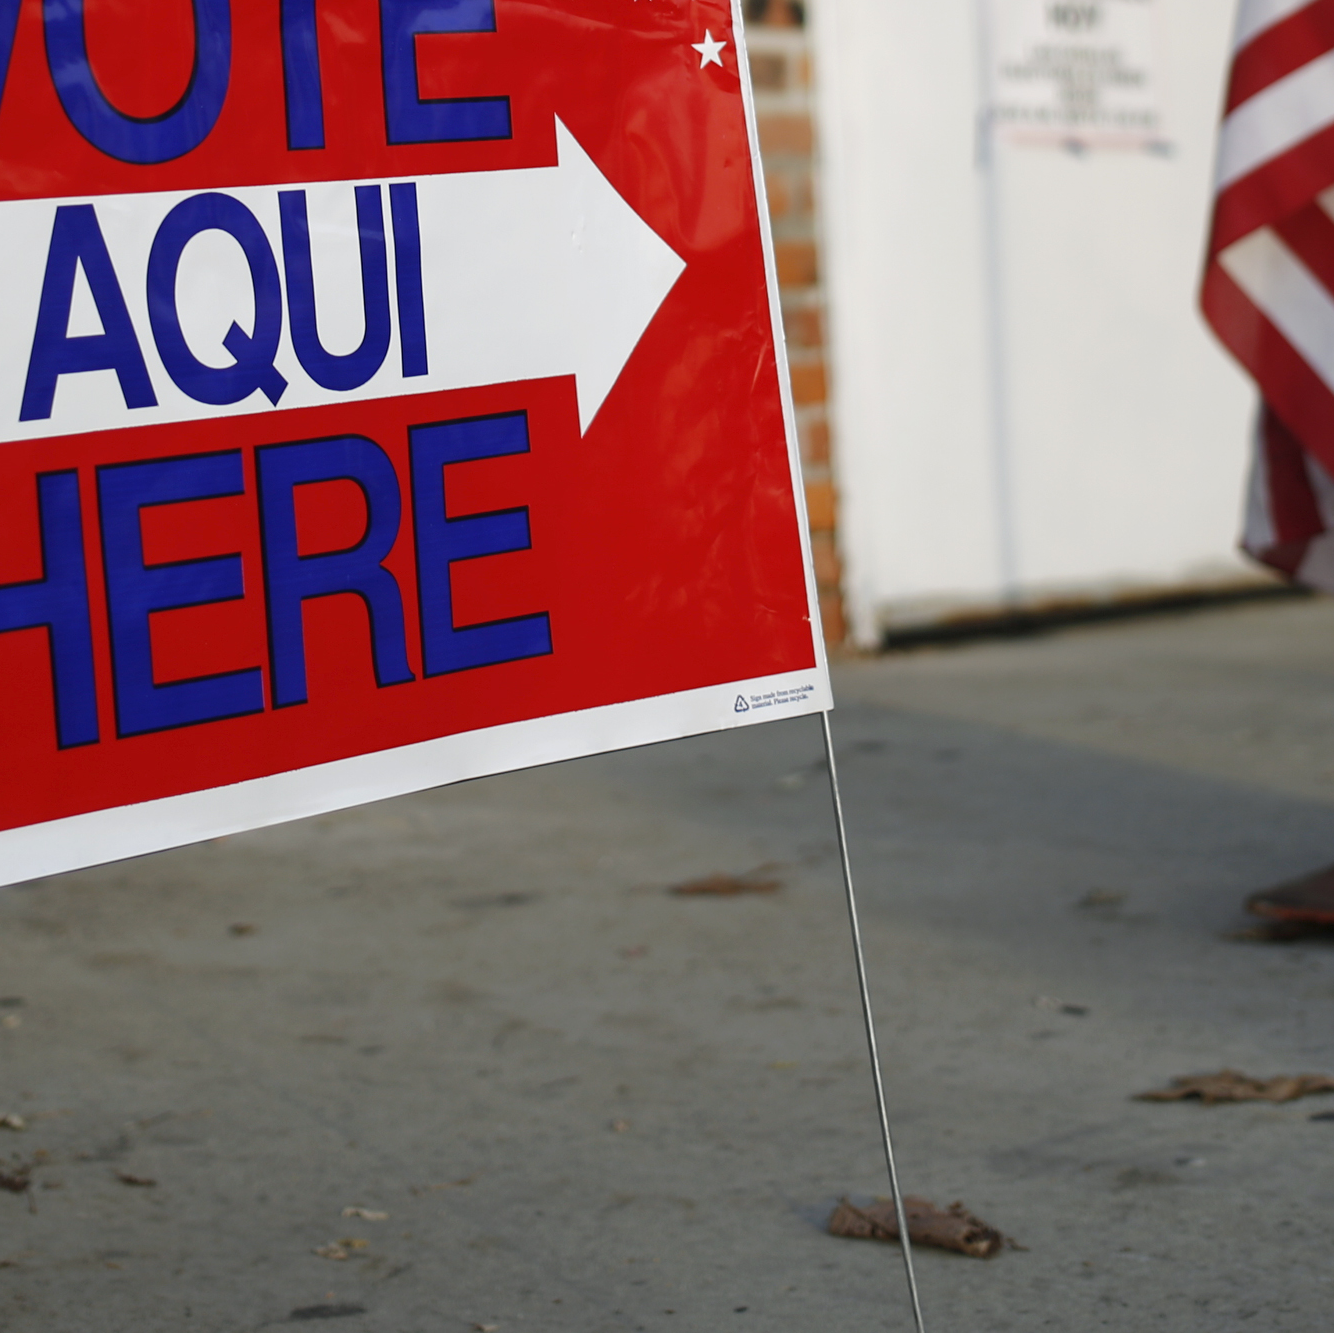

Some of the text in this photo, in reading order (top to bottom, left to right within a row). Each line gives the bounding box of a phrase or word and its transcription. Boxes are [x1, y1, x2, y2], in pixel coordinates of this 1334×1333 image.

[18, 181, 429, 423] AQUI
[750, 684, 814, 702] Sign made from recyclable
[751, 693, 809, 709] material. Please recycle.
